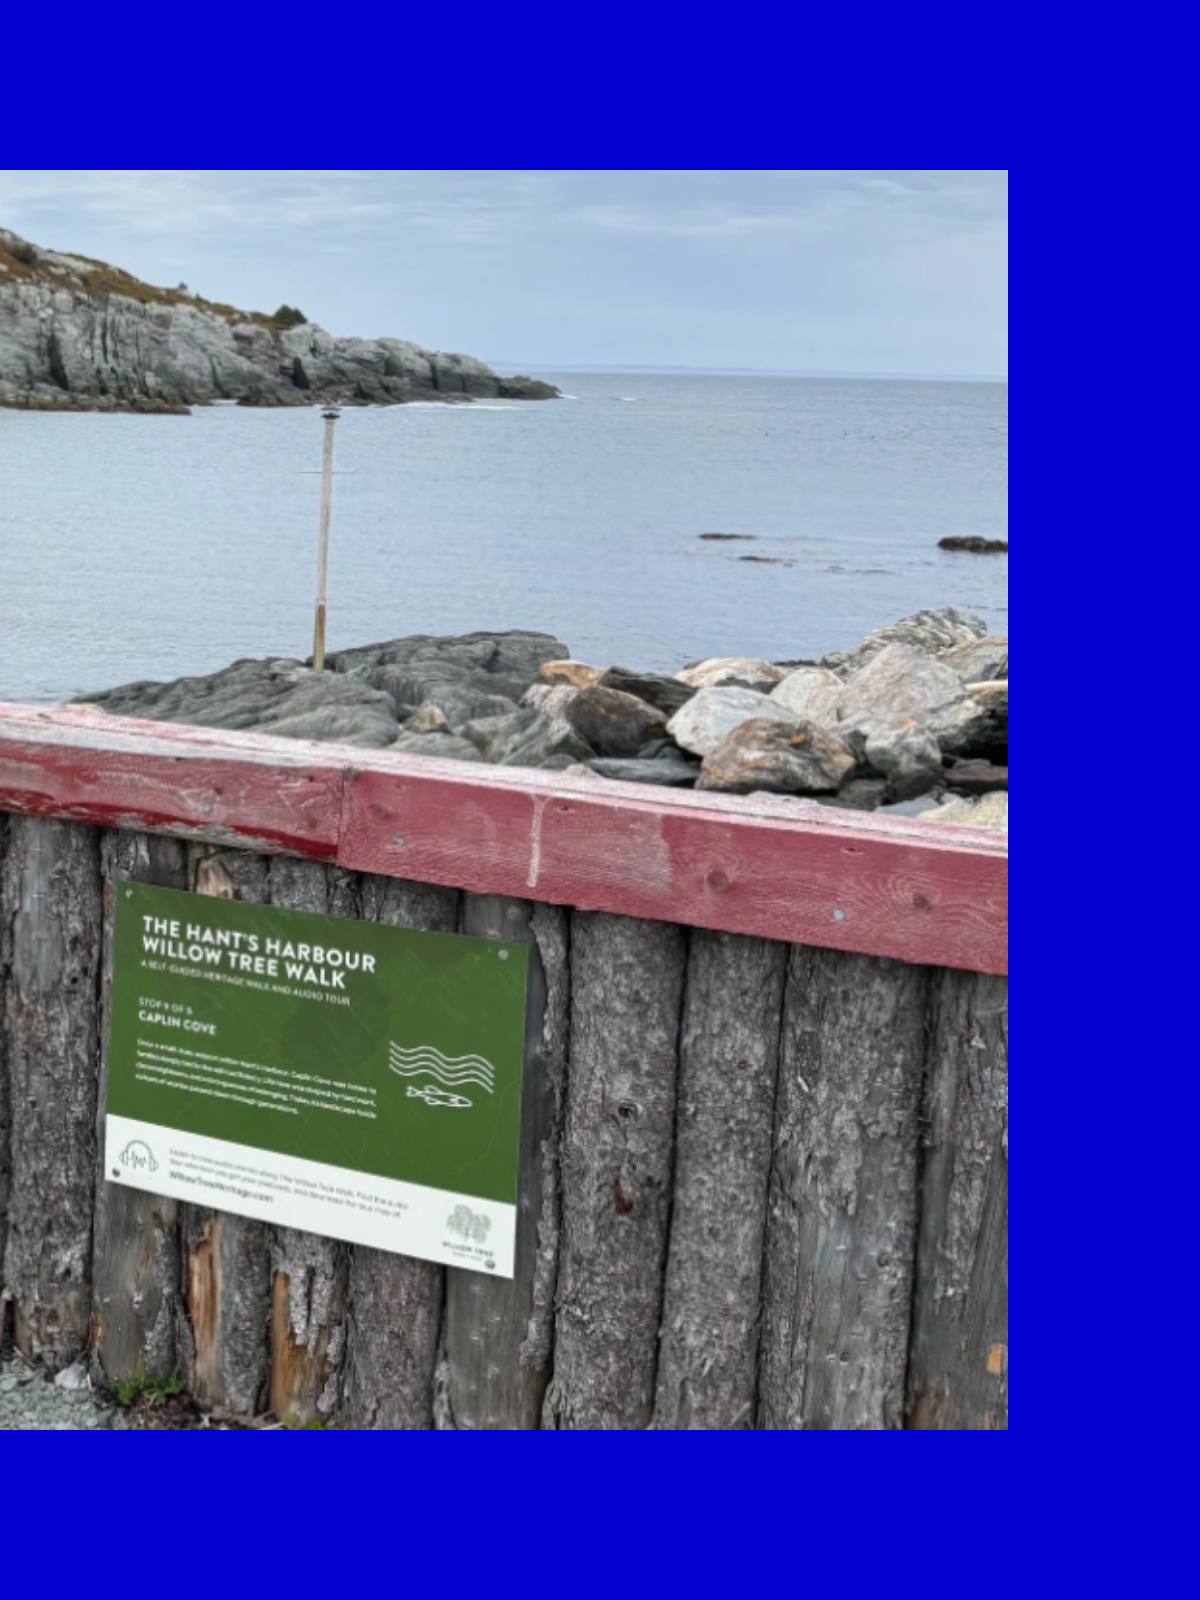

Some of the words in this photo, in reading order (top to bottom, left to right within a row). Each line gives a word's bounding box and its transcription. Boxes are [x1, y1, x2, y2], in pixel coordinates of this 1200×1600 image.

[142, 914, 180, 938] THE
[186, 922, 258, 953] HANT'S
[265, 936, 375, 973] HARBOUR
[142, 934, 222, 966] WILLOW
[227, 950, 278, 977] TREE
[284, 959, 345, 989] WALK
[139, 996, 162, 1009] STOP
[172, 1003, 184, 1013] OF
[140, 958, 147, 967] A
[148, 959, 201, 979] SELF-GUIDED
[203, 969, 244, 987] HERITAGE
[246, 977, 269, 991] WALK
[271, 982, 290, 995] AND
[293, 986, 323, 1001] AUDIO
[325, 992, 350, 1007] TOUR
[139, 1010, 181, 1028] CAPLIN
[183, 1019, 217, 1036] COVE
